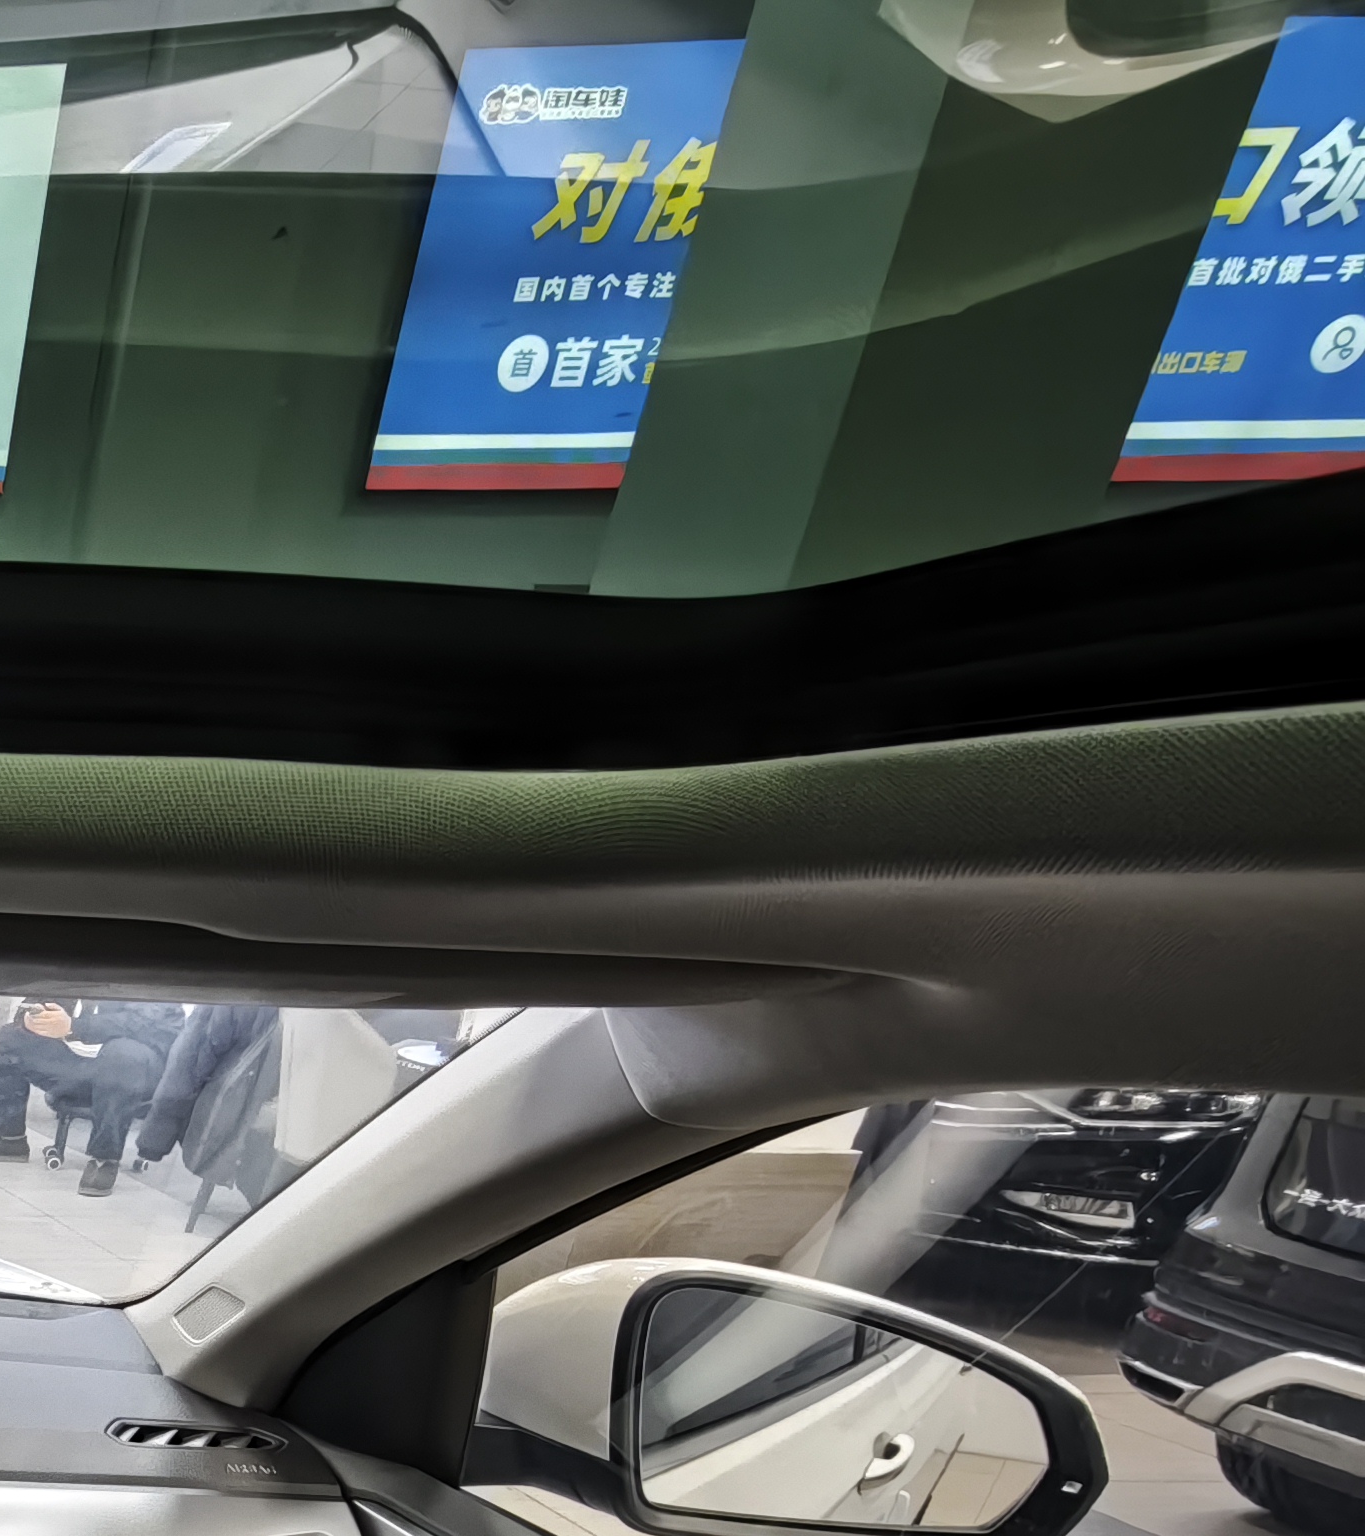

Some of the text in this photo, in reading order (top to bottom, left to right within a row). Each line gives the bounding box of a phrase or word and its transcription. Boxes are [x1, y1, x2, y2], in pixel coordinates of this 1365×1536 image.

[544, 88, 626, 108] 淘车娃
[513, 271, 677, 303] 国内首个专注
[549, 334, 645, 388] 首家
